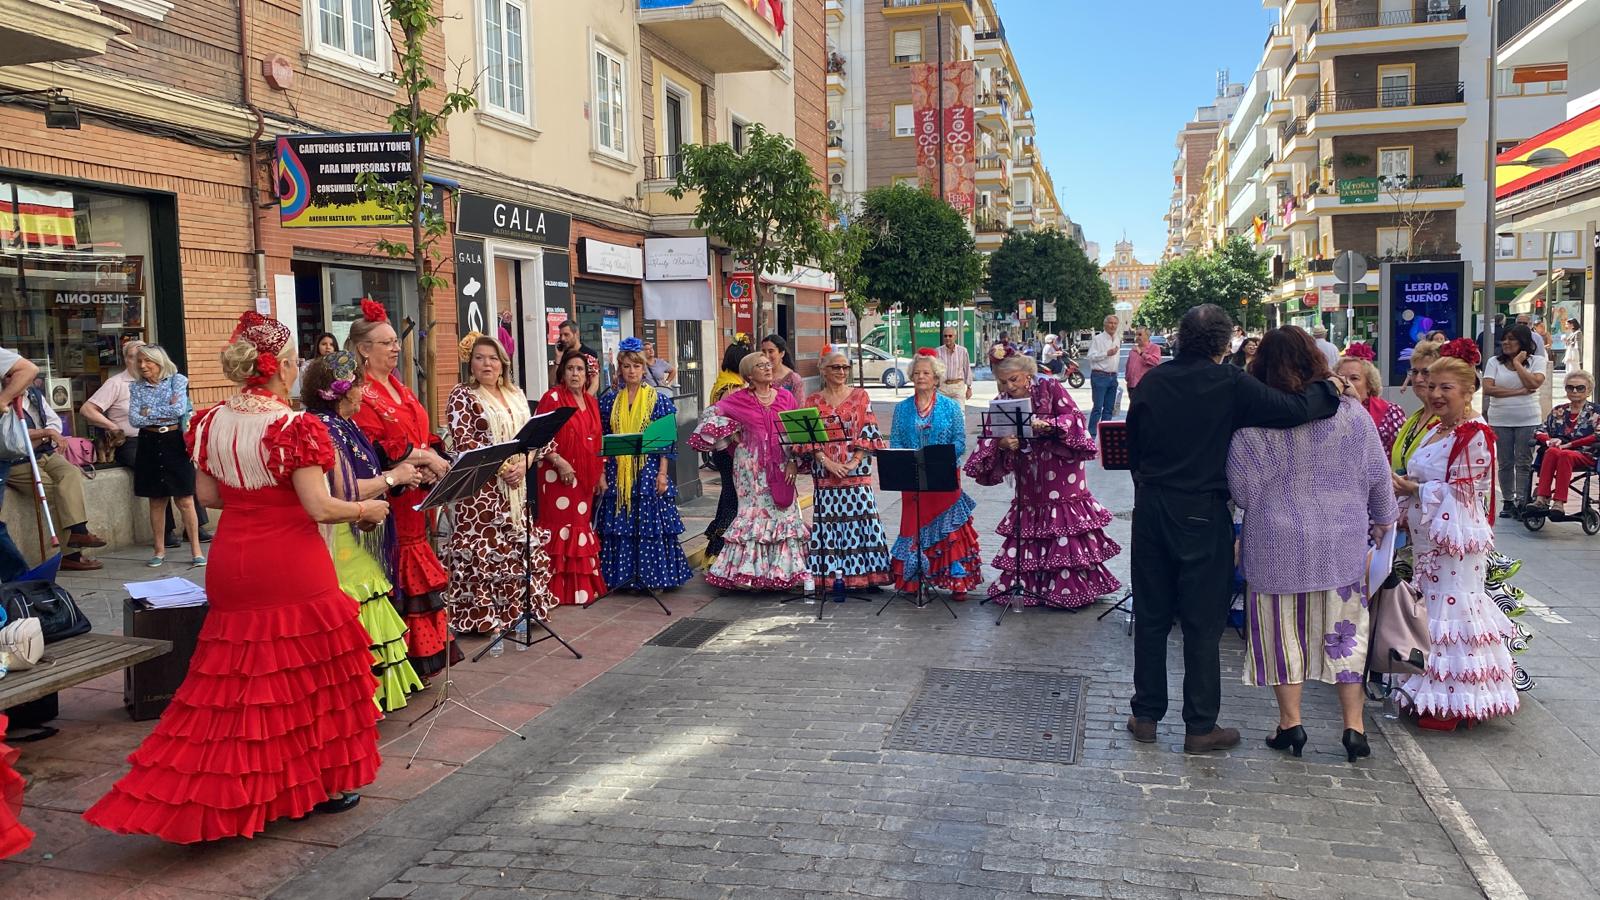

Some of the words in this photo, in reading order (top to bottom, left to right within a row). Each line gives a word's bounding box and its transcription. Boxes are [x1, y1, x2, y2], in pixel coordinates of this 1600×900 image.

[299, 144, 344, 154] CARTUCHOS
[346, 143, 355, 153] DE
[357, 142, 379, 152] TINTA
[380, 142, 385, 151] Y
[386, 141, 411, 151] TONER
[319, 164, 340, 174] PARA
[341, 162, 390, 173] IMPRESORAS
[391, 162, 396, 172] Y
[397, 161, 412, 172] FAX
[493, 203, 546, 235] GALA
[458, 252, 483, 264] GALA
[1405, 283, 1432, 292] LEER
[1434, 282, 1449, 291] DA
[1405, 292, 1449, 303] SUEÑOS
